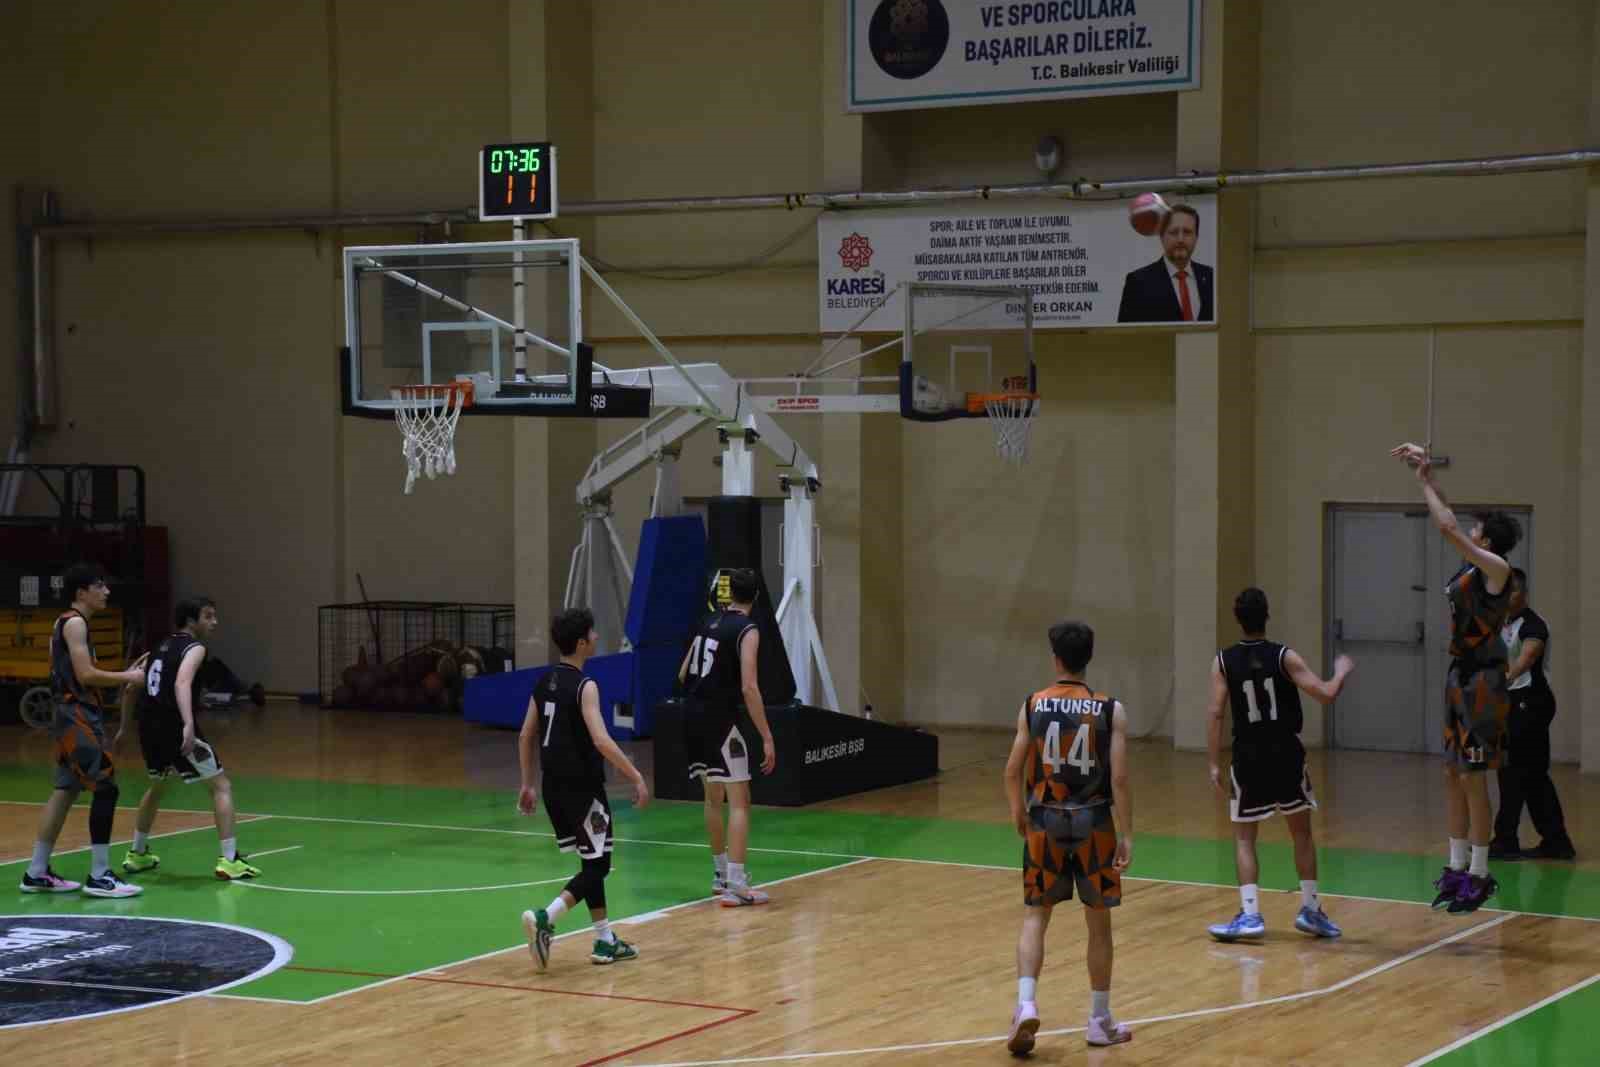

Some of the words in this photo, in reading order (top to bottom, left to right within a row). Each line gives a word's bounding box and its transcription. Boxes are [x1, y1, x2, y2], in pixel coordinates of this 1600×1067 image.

[981, 6, 1004, 28] VE
[1007, 0, 1137, 26] SPORCULARA
[964, 34, 1069, 66] BAŞARILAR
[1073, 22, 1153, 54] DİLERİZ.
[1031, 65, 1056, 81] T.C.
[1060, 60, 1125, 79] Balıkesir
[1128, 55, 1180, 74] Valiliği
[491, 148, 540, 174] 07:36
[976, 220, 987, 231] VE
[989, 217, 1022, 230] TOPLUM
[1024, 215, 1037, 228] İLE
[930, 236, 957, 249] DAİMA
[959, 234, 983, 248] AKTİF
[984, 234, 1016, 248] YAŞAMI
[914, 252, 982, 265] MÜSABAKALARA
[983, 250, 1018, 264] KATILAN
[1020, 248, 1039, 262] TÜM
[827, 272, 886, 295] KARESİ
[917, 269, 950, 281] SPORCU
[951, 268, 962, 281] VE
[963, 267, 1011, 281] KULÜPLERE
[1012, 265, 1060, 280] BAŞARILAR
[1061, 263, 1087, 277] DİLER
[1049, 301, 1094, 314] ORKAN
[689, 635, 719, 679] 15
[147, 659, 163, 697] 6
[1035, 697, 1103, 718] ALTUNSU
[1242, 677, 1278, 723] 11
[542, 702, 556, 747] 7
[804, 740, 847, 765] BALIKESİR
[1041, 720, 1096, 776] 44
